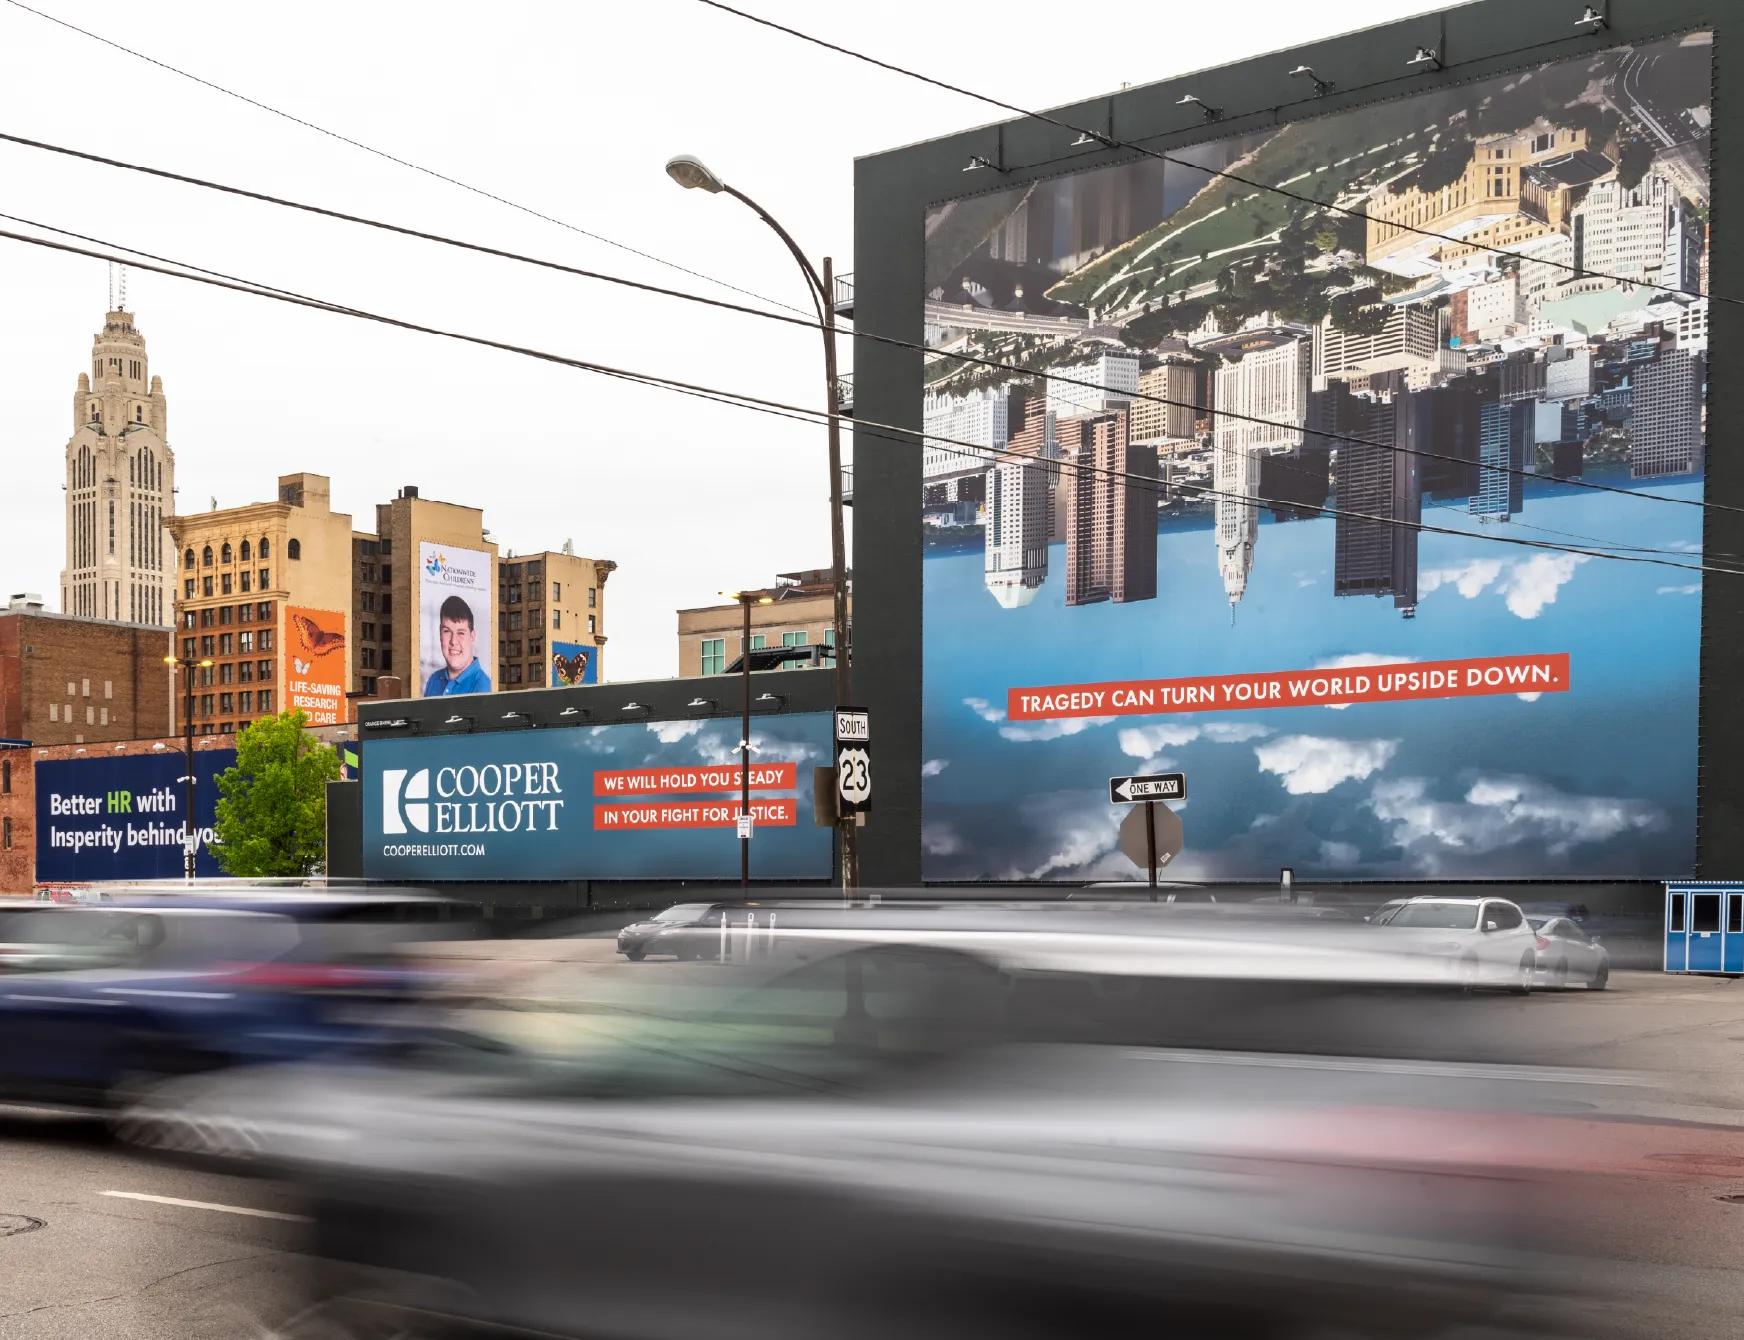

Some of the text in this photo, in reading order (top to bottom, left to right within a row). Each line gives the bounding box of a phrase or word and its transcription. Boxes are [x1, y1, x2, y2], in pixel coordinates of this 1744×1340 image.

[290, 681, 341, 696] LIFE-SAVING
[1021, 664, 1559, 713] TRAGEDY CAN TURN YOUR WORLD UPSIDE DOWN.
[294, 696, 337, 710] RESEARCH
[315, 712, 336, 724] CARE
[840, 718, 866, 735] SOUTH
[436, 762, 562, 797] COOPER
[604, 770, 784, 790] WE WILL HOLD YOU SEADY
[842, 759, 868, 791] 23
[1130, 781, 1176, 794] ONE WAY
[50, 787, 175, 815] Better HR with
[435, 800, 564, 833] ELLIOTT
[604, 811, 618, 824] IN
[622, 810, 658, 823] YOUR
[662, 809, 699, 822] FIGHT
[703, 808, 729, 821] FOR
[51, 824, 123, 853] Insperity
[127, 821, 186, 846] behind
[384, 844, 485, 856] COOPERELLIOTT.COM
